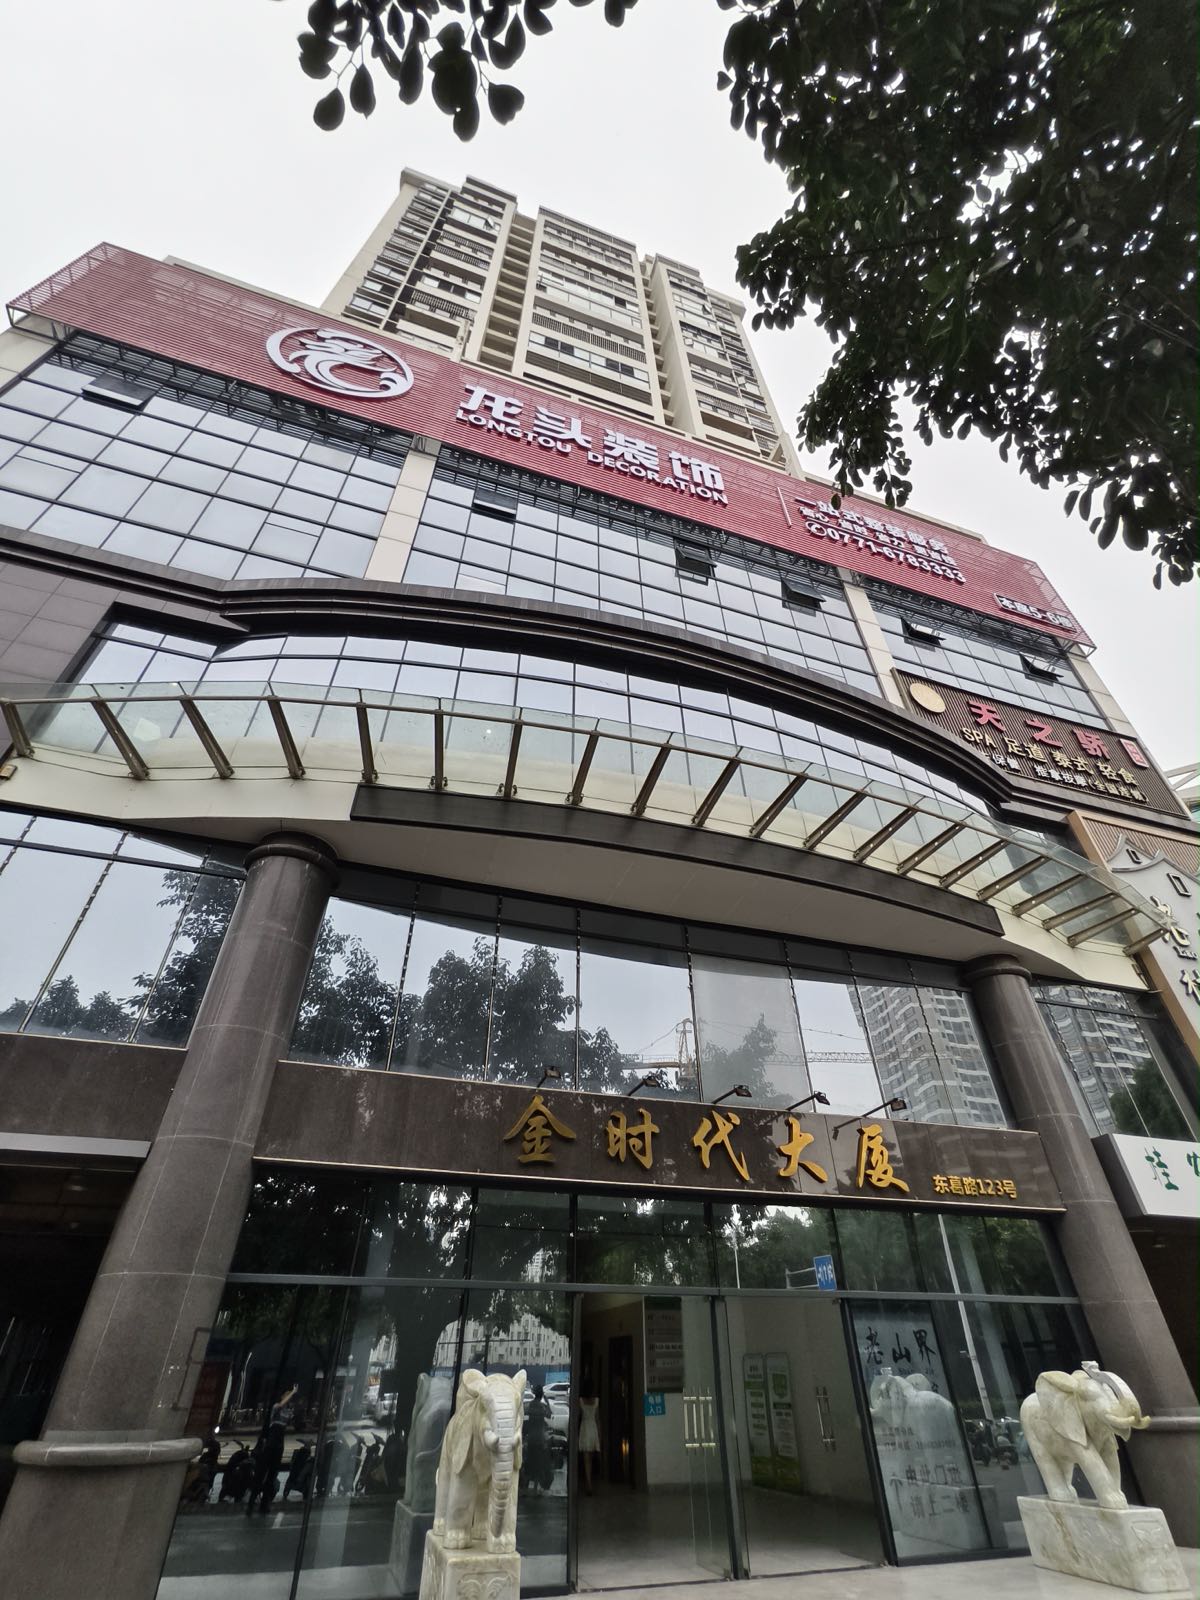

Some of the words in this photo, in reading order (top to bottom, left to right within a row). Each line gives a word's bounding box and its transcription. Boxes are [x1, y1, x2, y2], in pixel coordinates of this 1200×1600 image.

[456, 409, 572, 454] LONGTOU
[587, 450, 729, 505] DECORATION
[459, 384, 726, 492] 龙头装饰
[826, 526, 966, 584] 0771-6783333
[960, 726, 998, 749] SPA
[1003, 737, 1048, 764] 足道
[1051, 750, 1094, 776] 泰式
[1097, 762, 1139, 787] 轻食
[967, 699, 1111, 761] 天之骄
[502, 1093, 911, 1194] 金时代大厦
[931, 1173, 1019, 1199] 东葛路123号
[863, 1325, 937, 1365] 老山界
